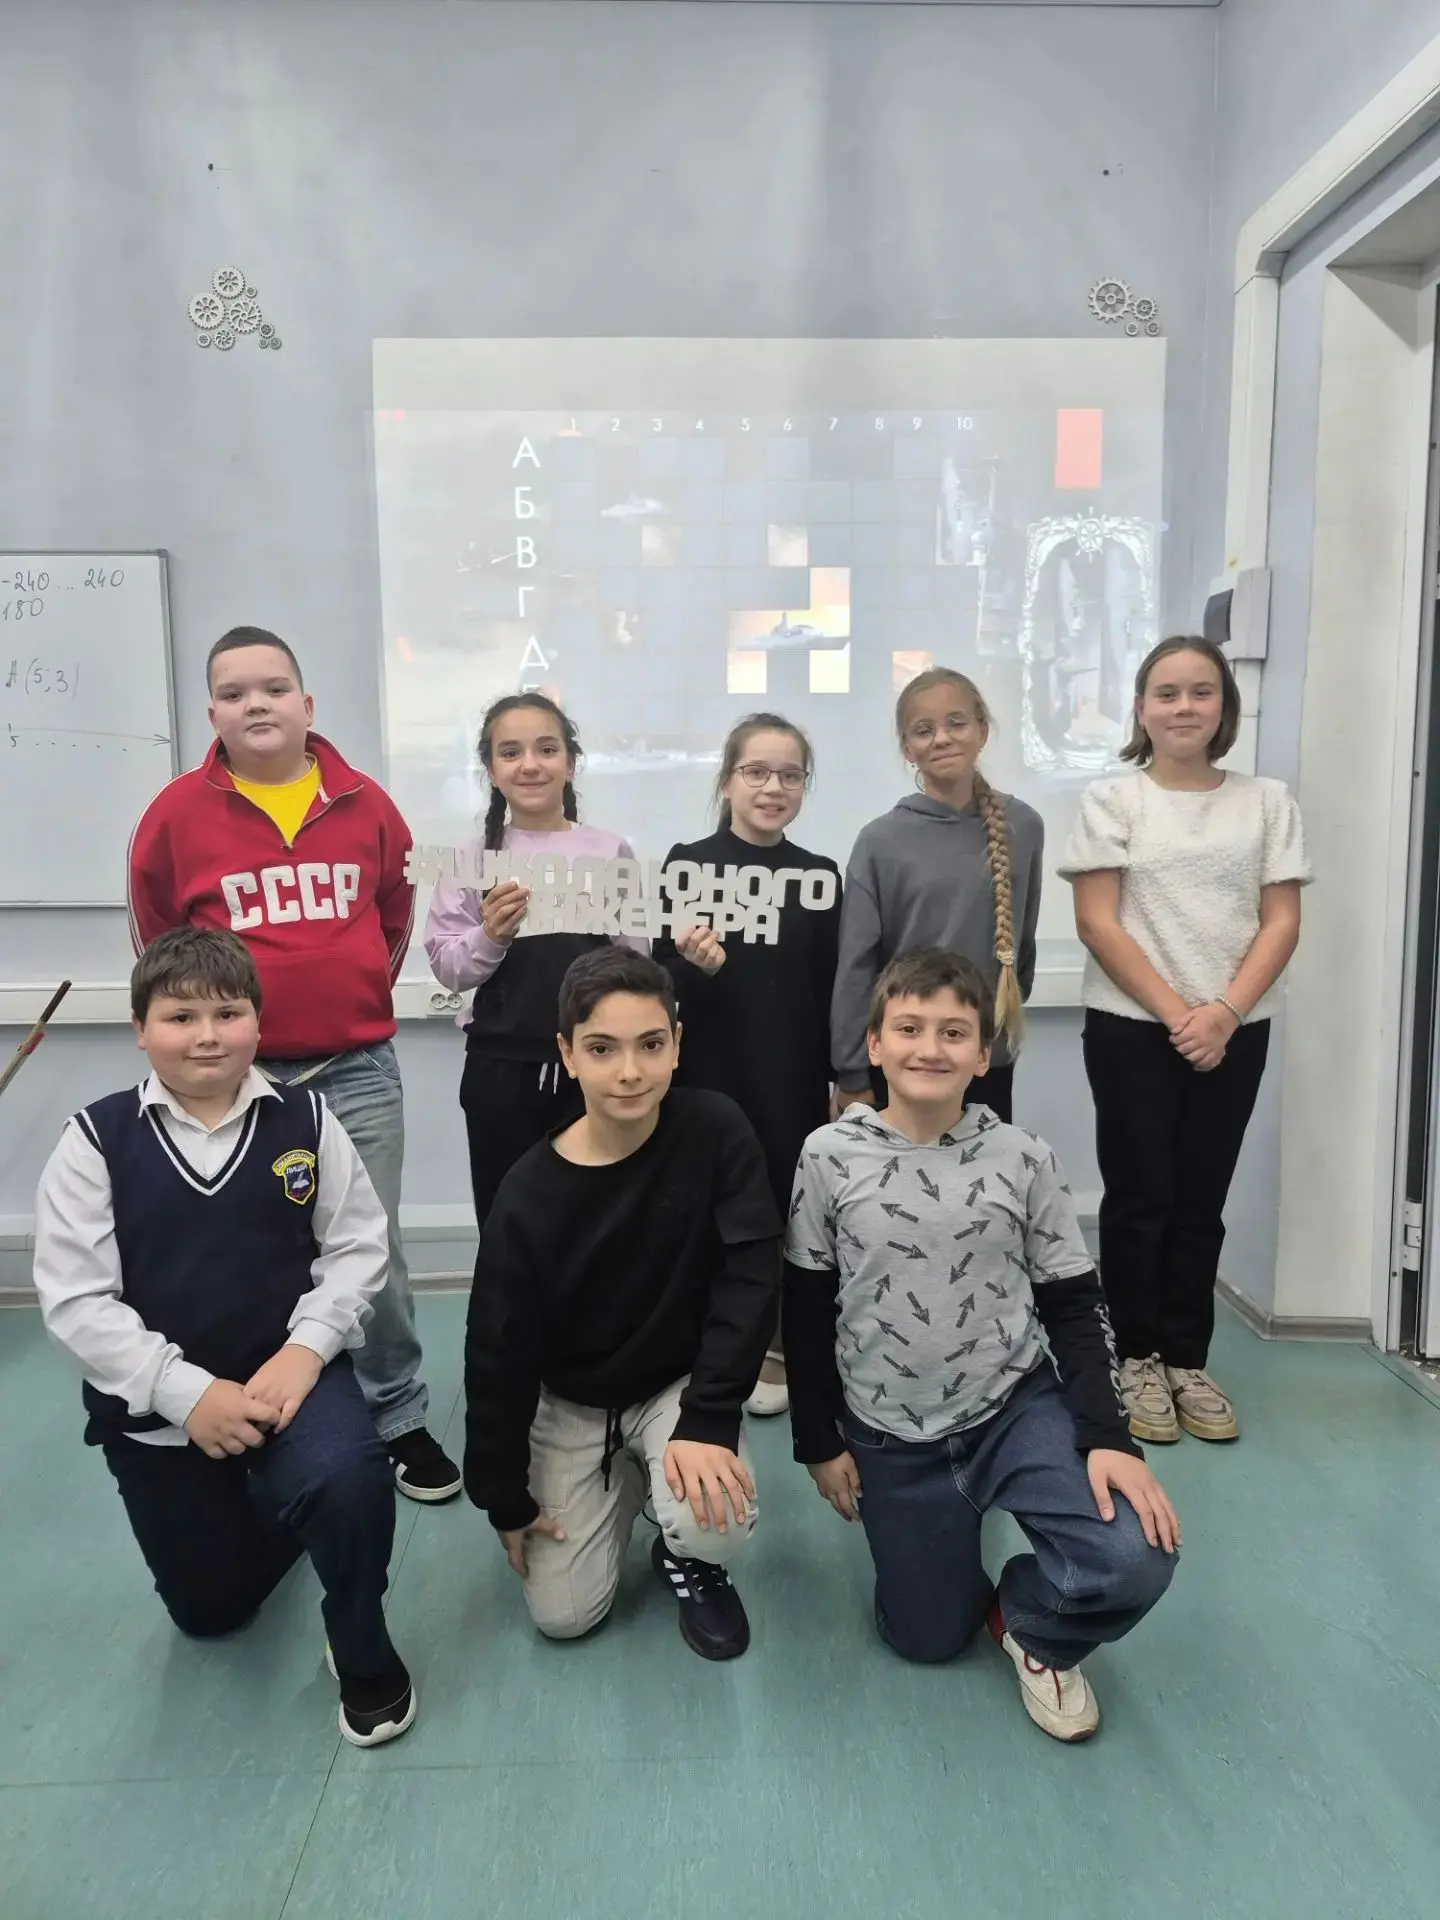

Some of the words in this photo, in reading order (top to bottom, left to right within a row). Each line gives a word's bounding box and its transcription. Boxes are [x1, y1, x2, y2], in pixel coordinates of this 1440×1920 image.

[611, 418, 621, 432] 2
[652, 418, 663, 432] 3
[695, 418, 705, 431] 4
[740, 417, 751, 432] 5
[783, 417, 793, 431] 6
[828, 416, 839, 431] 7
[874, 417, 885, 431] 8
[912, 416, 923, 431] 9
[955, 416, 974, 431] 10
[512, 435, 542, 468] А
[514, 486, 535, 519] Б
[516, 536, 537, 568] В
[84, 568, 125, 589] 240
[2, 597, 44, 620] 180
[518, 586, 535, 618] Г
[519, 634, 549, 671] Д
[221, 863, 361, 931] СССР
[650, 859, 837, 911] ЮНОГО
